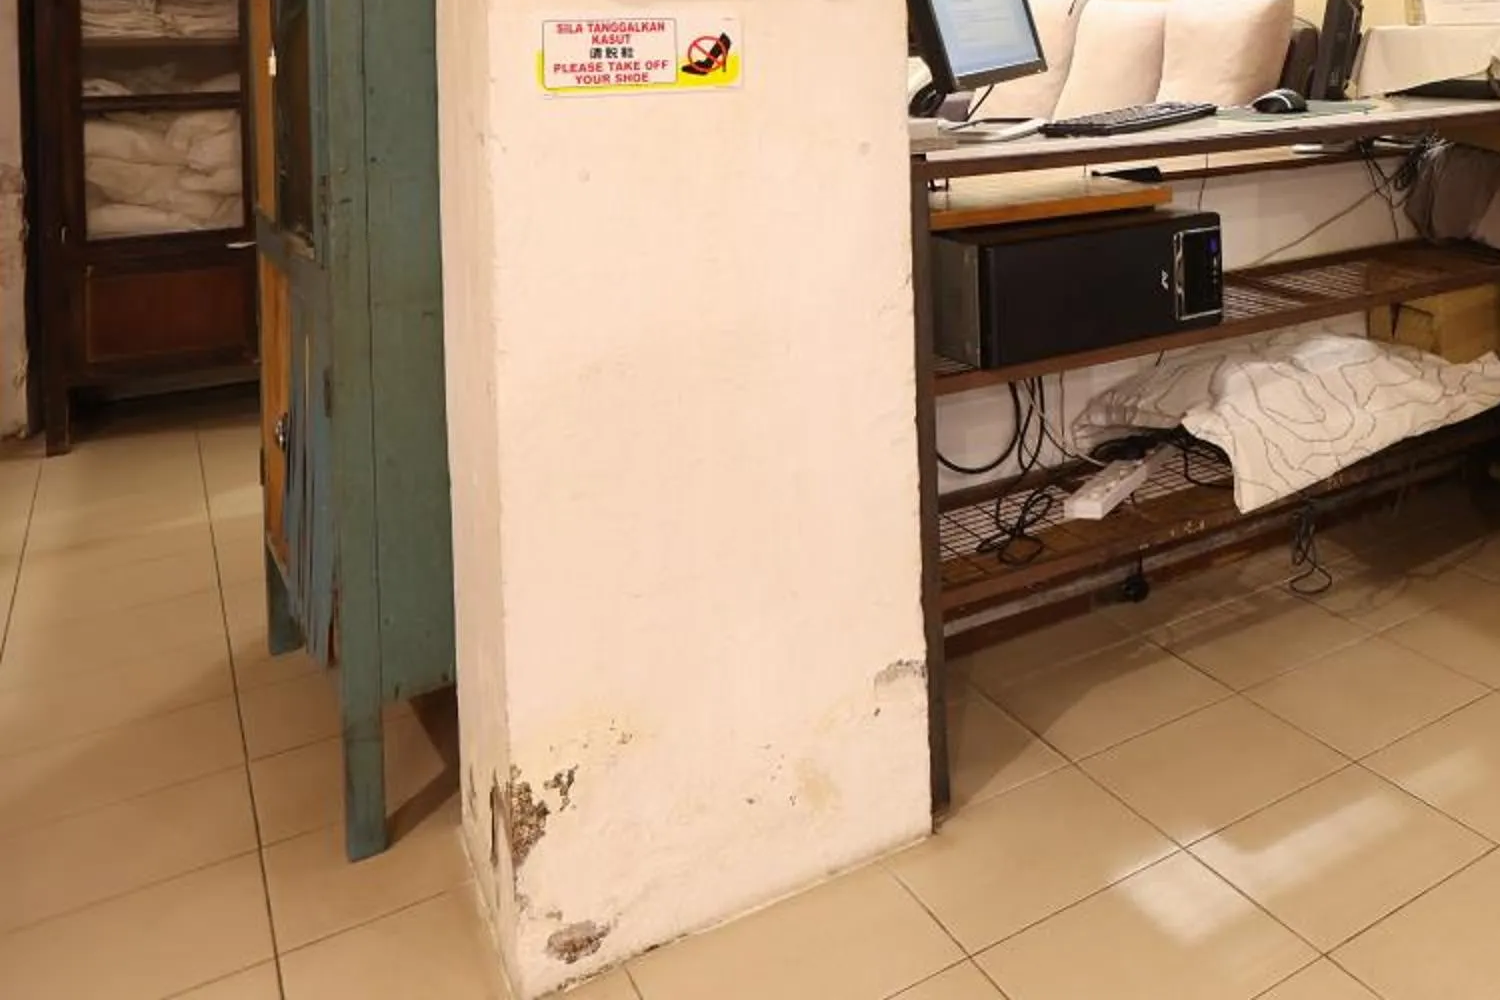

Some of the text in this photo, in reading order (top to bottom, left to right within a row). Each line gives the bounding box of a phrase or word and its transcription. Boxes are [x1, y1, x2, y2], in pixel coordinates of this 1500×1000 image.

[556, 21, 665, 34] SILA TANGGALKAN
[591, 33, 632, 45] KASUT
[553, 60, 669, 74] PLEASE TAKE OFF
[575, 72, 649, 85] YOUR SHOE
